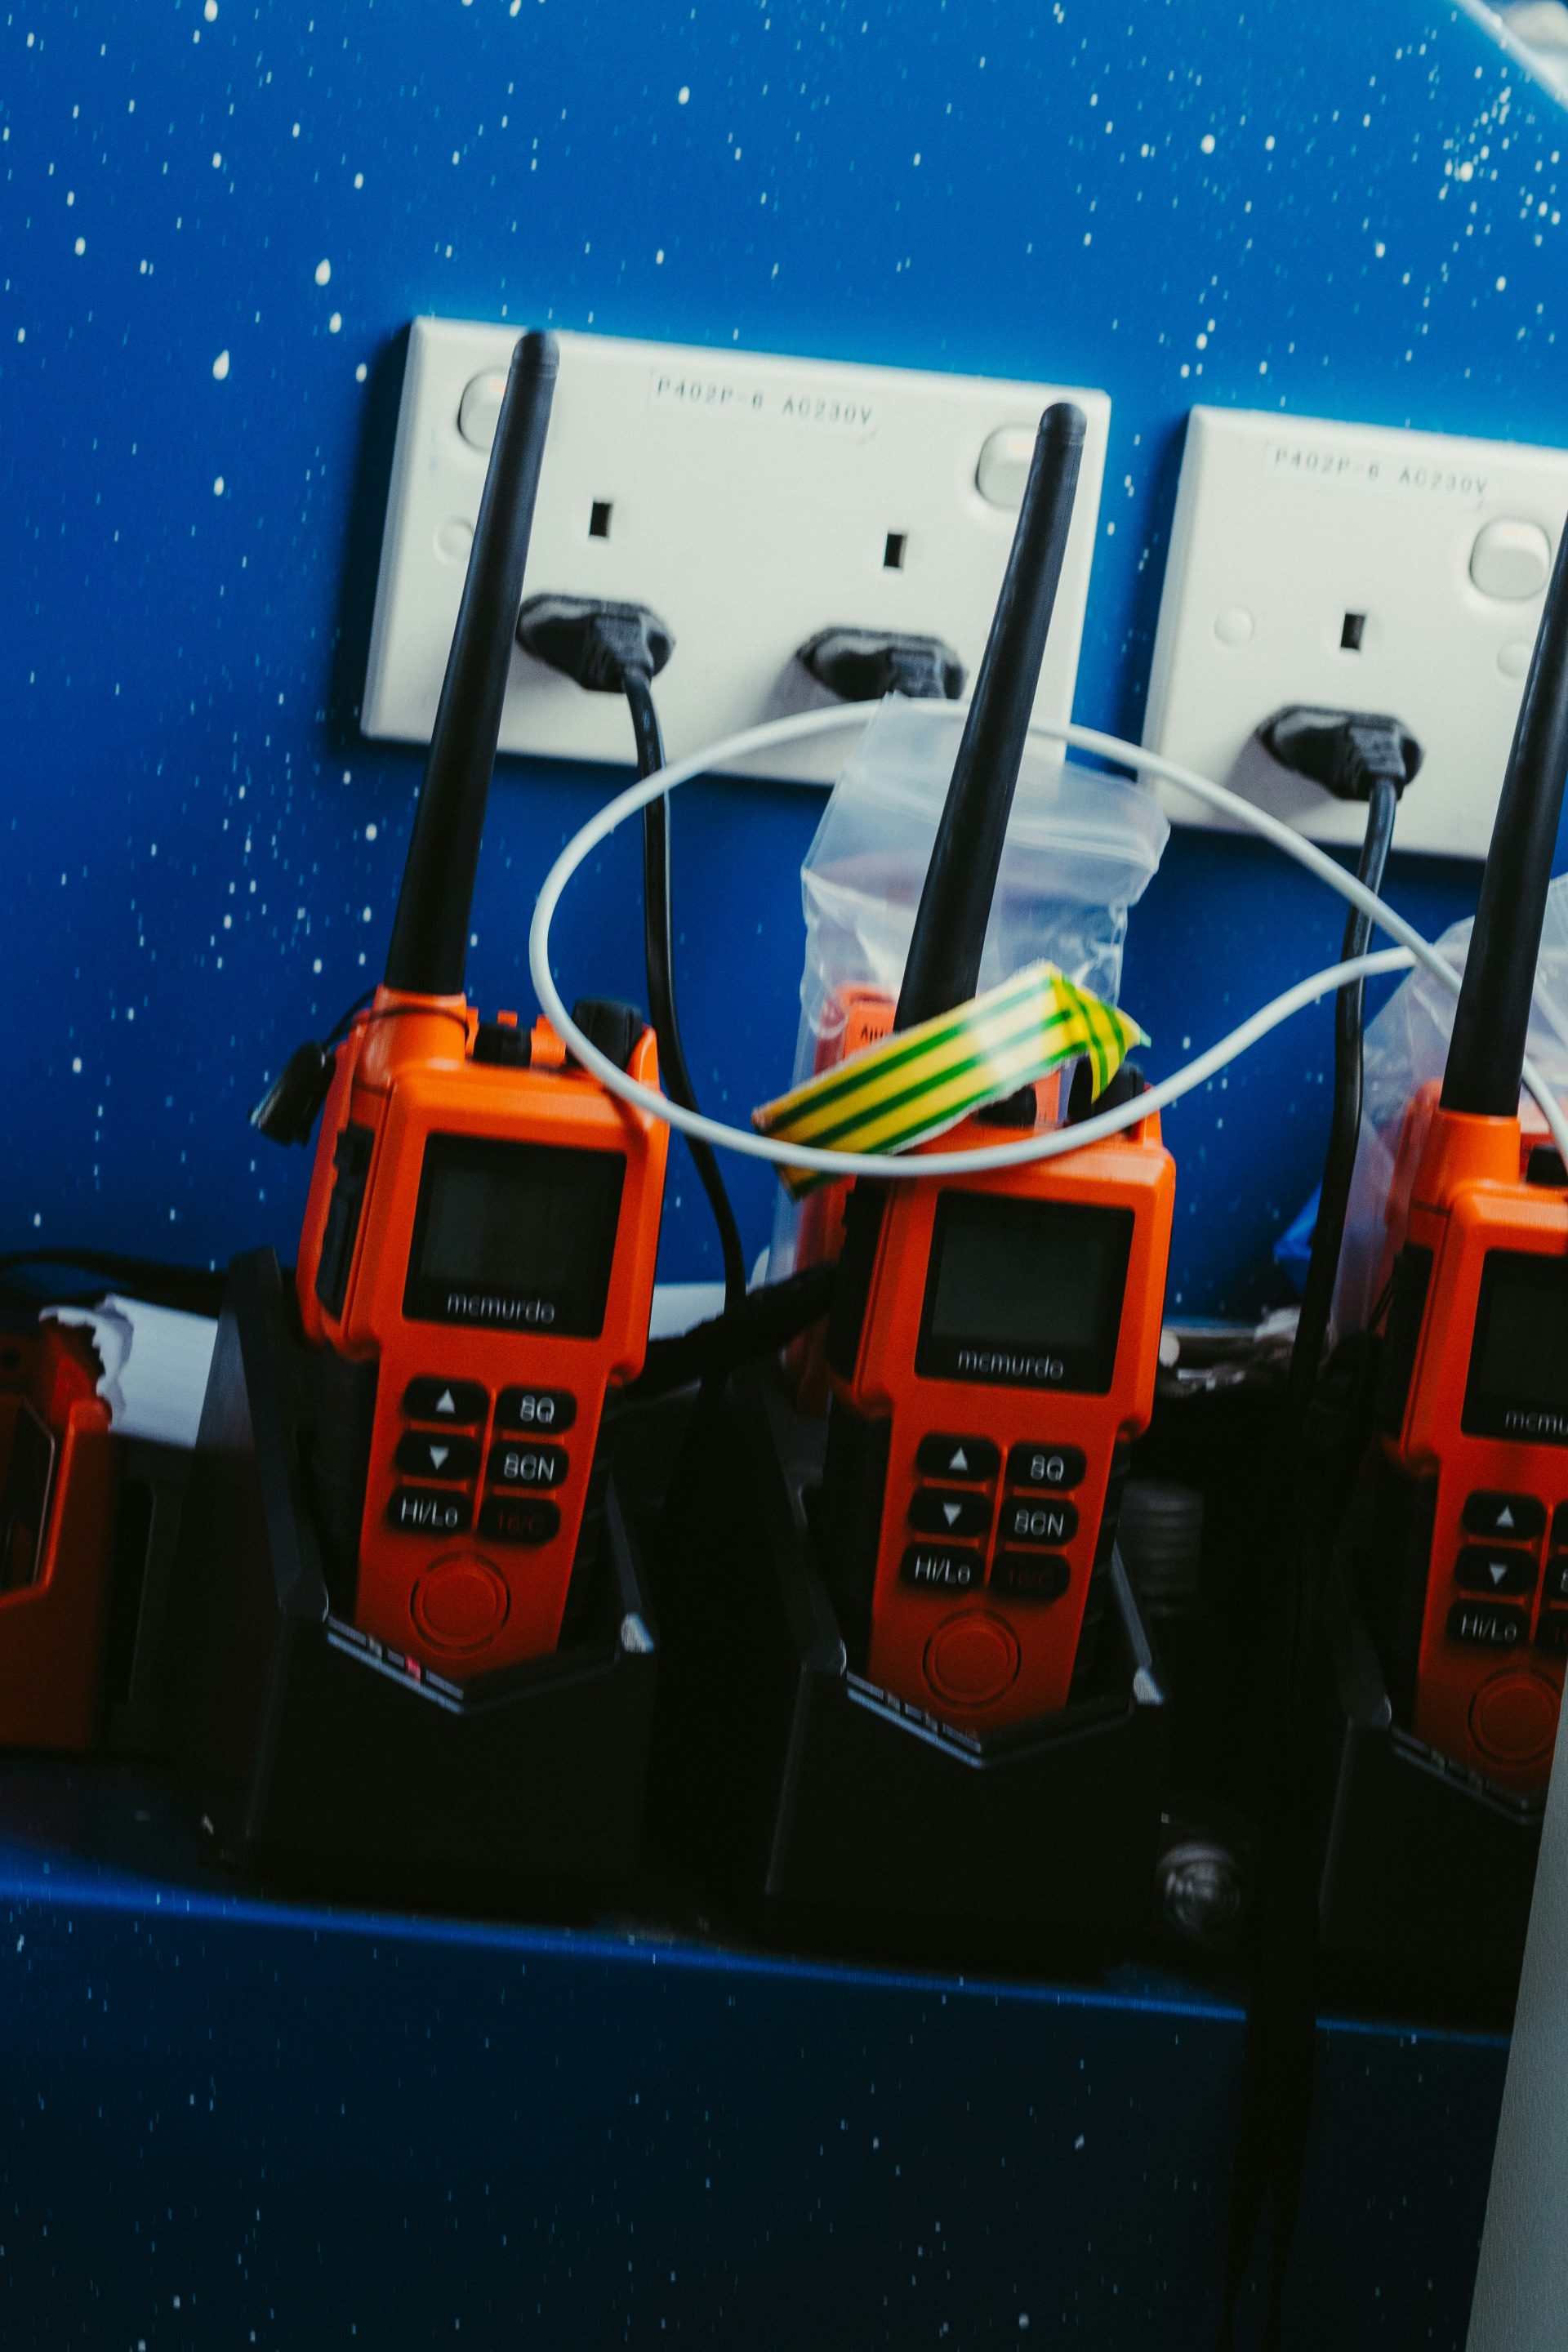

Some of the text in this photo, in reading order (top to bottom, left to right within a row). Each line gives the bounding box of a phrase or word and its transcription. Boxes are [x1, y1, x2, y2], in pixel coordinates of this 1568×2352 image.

[782, 394, 872, 425] AC230V
[1399, 466, 1487, 495] AC230V
[447, 1294, 555, 1325] mcmurdo
[957, 1350, 1064, 1380] mcmurdo
